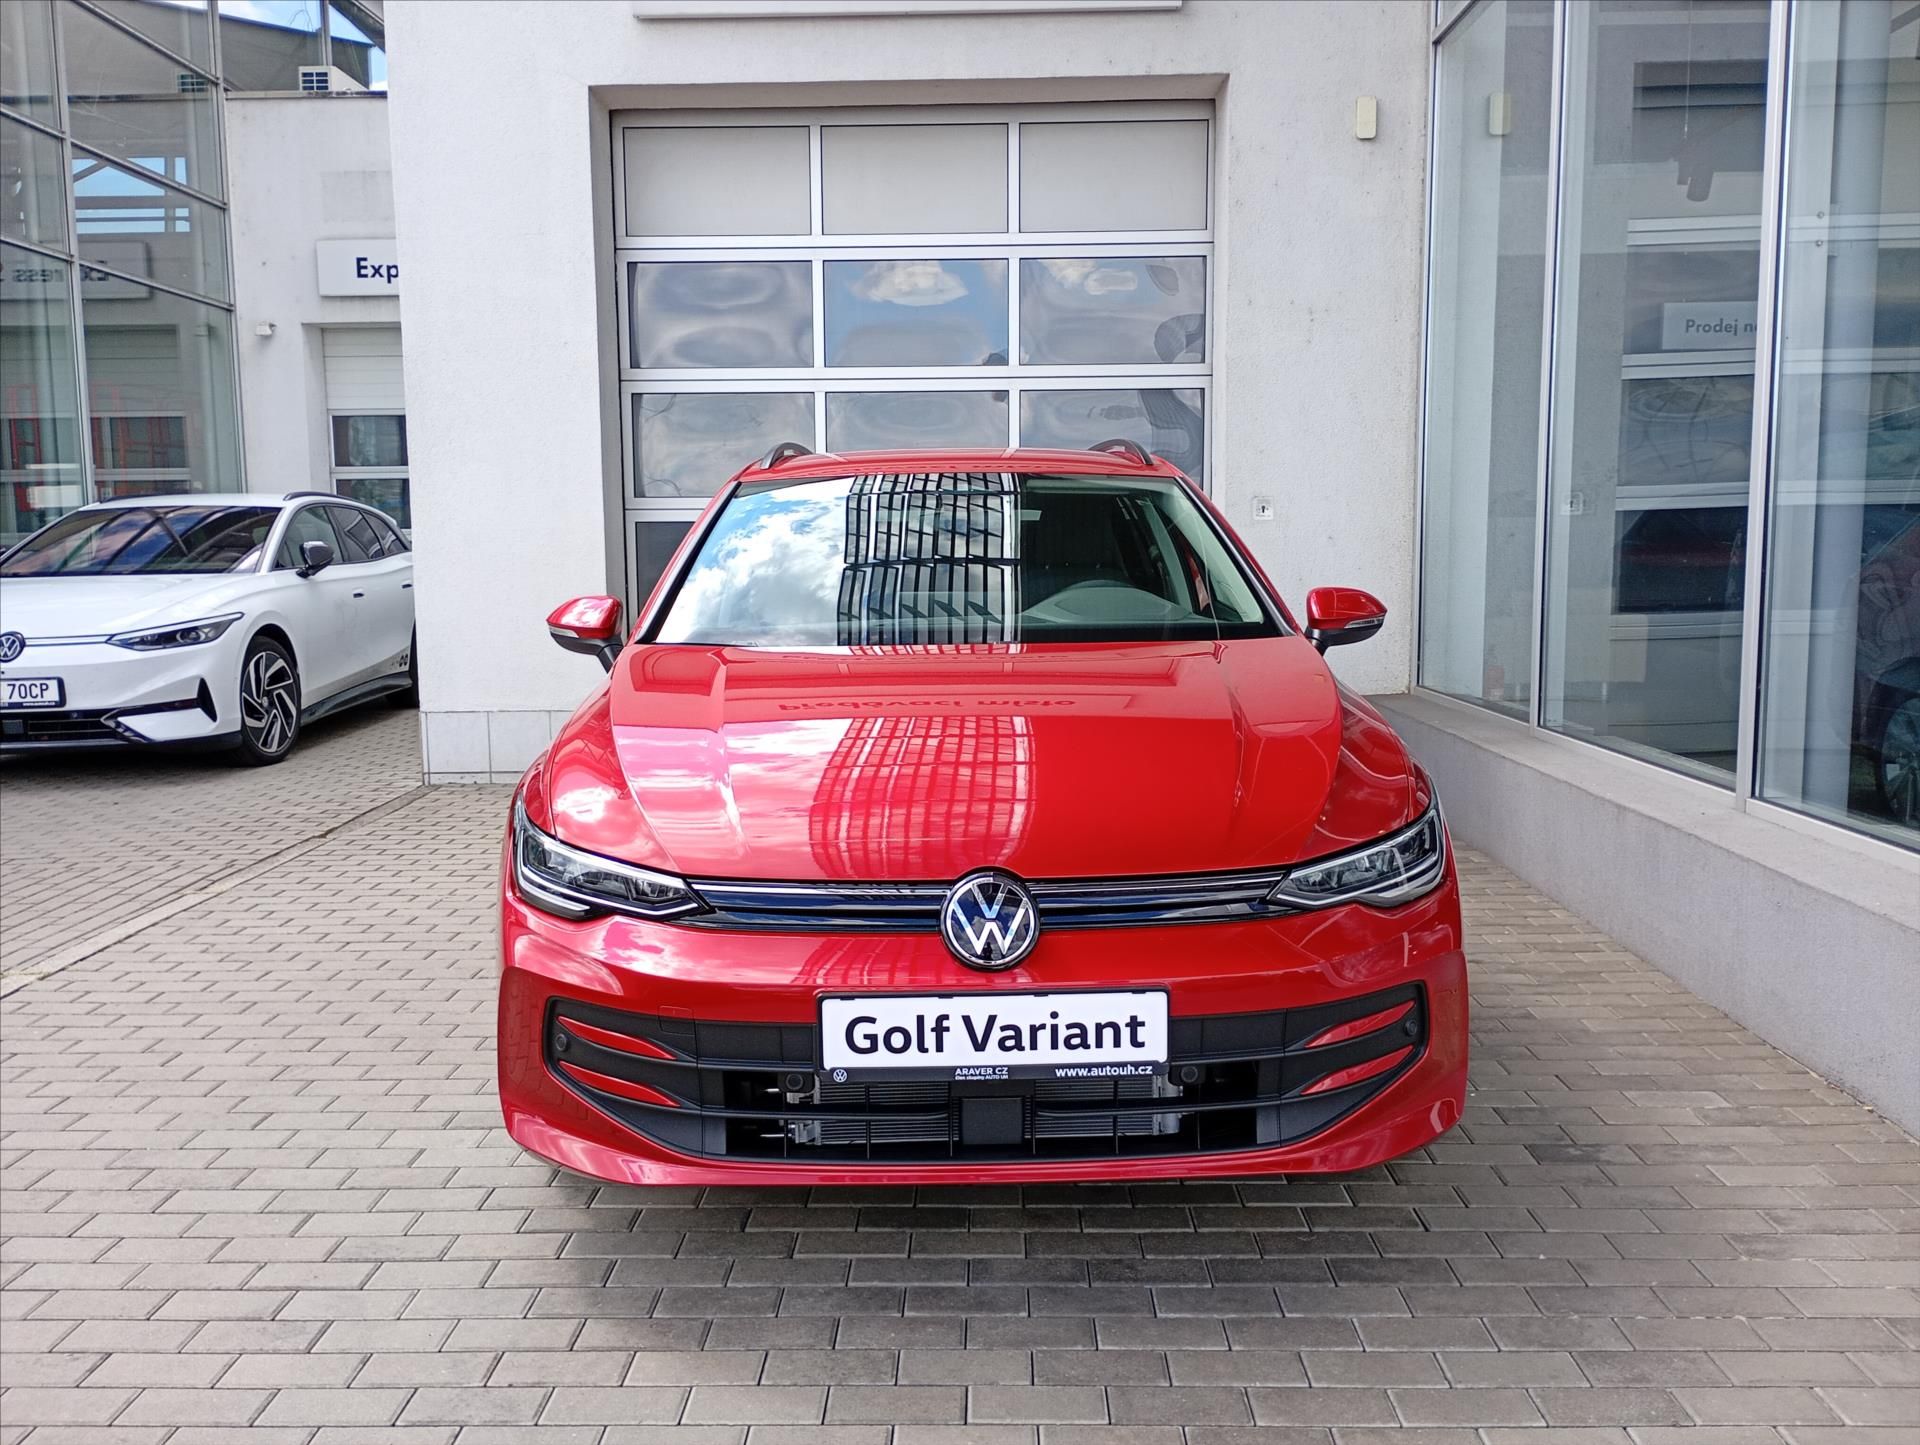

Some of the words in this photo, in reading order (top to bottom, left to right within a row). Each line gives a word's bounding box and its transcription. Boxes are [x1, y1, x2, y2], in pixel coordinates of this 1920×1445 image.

[356, 257, 399, 284] Exp
[1685, 319, 1738, 336] Prodej
[1744, 323, 1757, 333] n
[7, 683, 49, 699] 70CP
[845, 1014, 950, 1054] Golf
[961, 1011, 1146, 1052] Variant
[955, 1067, 993, 1075] ARAVER
[995, 1067, 1008, 1075] CZ
[1055, 1064, 1153, 1077] www.autouh.cz
